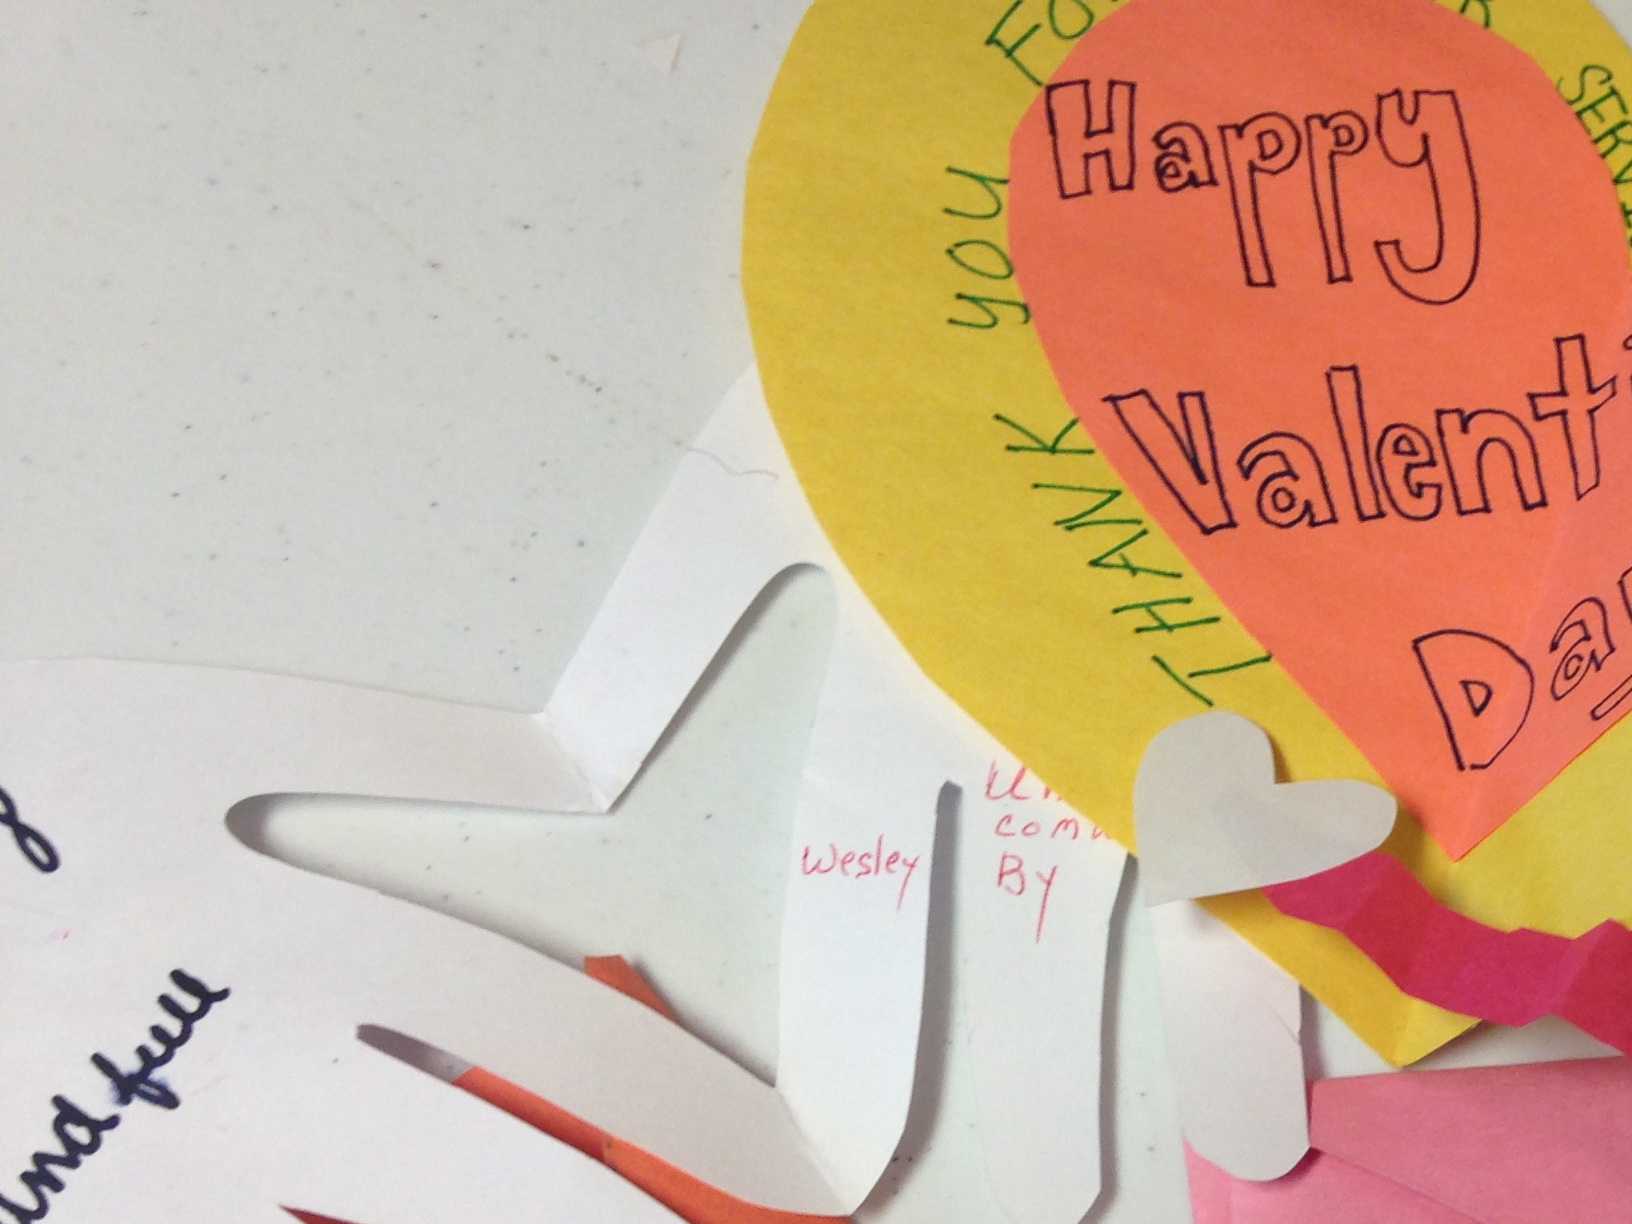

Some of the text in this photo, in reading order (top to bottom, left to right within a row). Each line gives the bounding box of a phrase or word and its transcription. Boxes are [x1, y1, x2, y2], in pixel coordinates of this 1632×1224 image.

[942, 165, 1031, 328] YOU
[1044, 78, 1482, 305] Happy
[993, 413, 1273, 708] THANK
[800, 834, 921, 911] Wesley
[996, 851, 1059, 945] By
